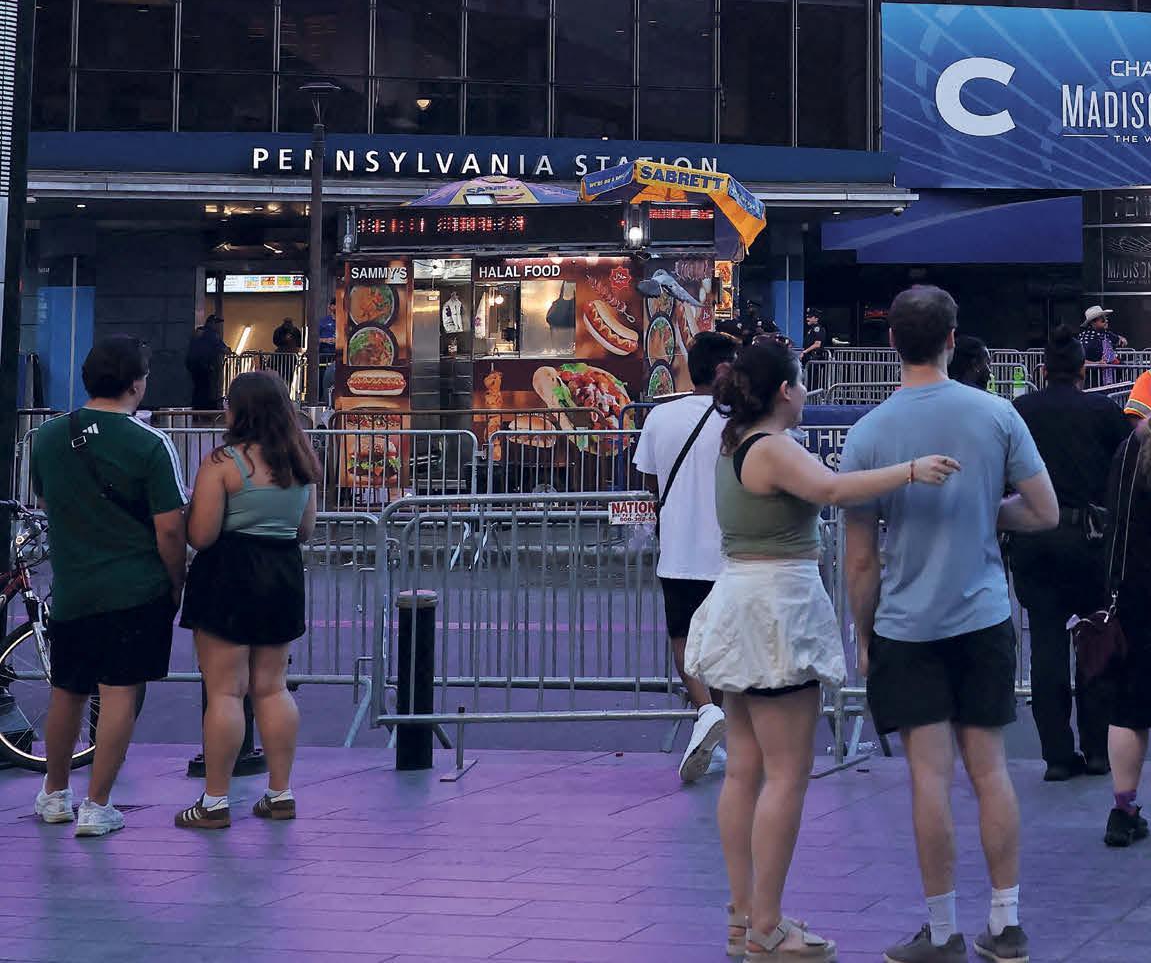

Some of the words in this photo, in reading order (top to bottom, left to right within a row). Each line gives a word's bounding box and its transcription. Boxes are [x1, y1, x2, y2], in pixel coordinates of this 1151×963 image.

[935, 57, 1016, 136] C
[1113, 135, 1138, 144] THE
[575, 153, 718, 175] STON
[640, 165, 724, 190] SABRETT
[351, 267, 407, 279] SAMMY'S
[479, 265, 520, 278] HALAL
[524, 264, 560, 277] FOOD
